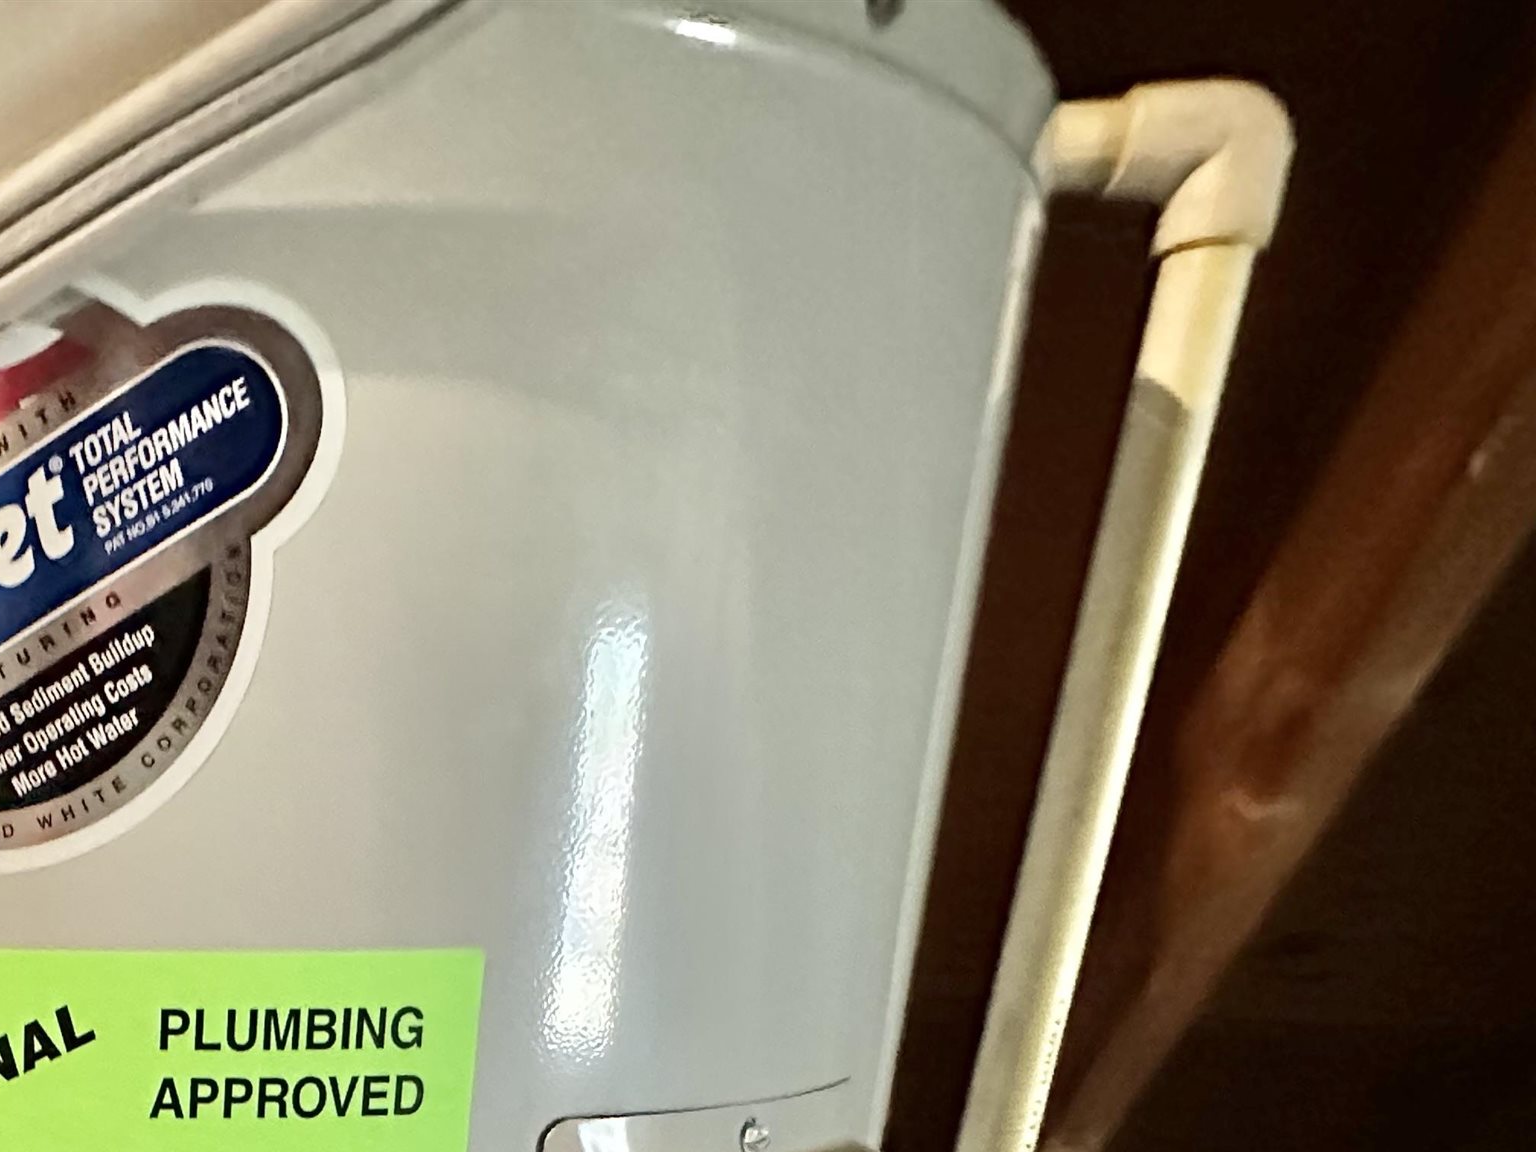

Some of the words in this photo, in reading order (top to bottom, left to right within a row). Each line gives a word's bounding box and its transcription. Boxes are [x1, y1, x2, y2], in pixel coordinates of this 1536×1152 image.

[69, 411, 142, 475] TOTAL
[83, 376, 251, 506] PERFORMANCE
[92, 457, 184, 538] SYSTEM
[10, 661, 91, 725] Sediment
[88, 624, 155, 676] Buildup
[24, 693, 105, 751] Operating
[104, 664, 154, 706] Costs
[37, 775, 128, 831] WHITE
[140, 544, 243, 768] CORPORATION
[11, 758, 57, 798] More
[55, 736, 87, 770] Hot
[87, 707, 140, 749] Water
[158, 1005, 425, 1053] PLUMBING
[149, 1074, 425, 1120] APPROVED
